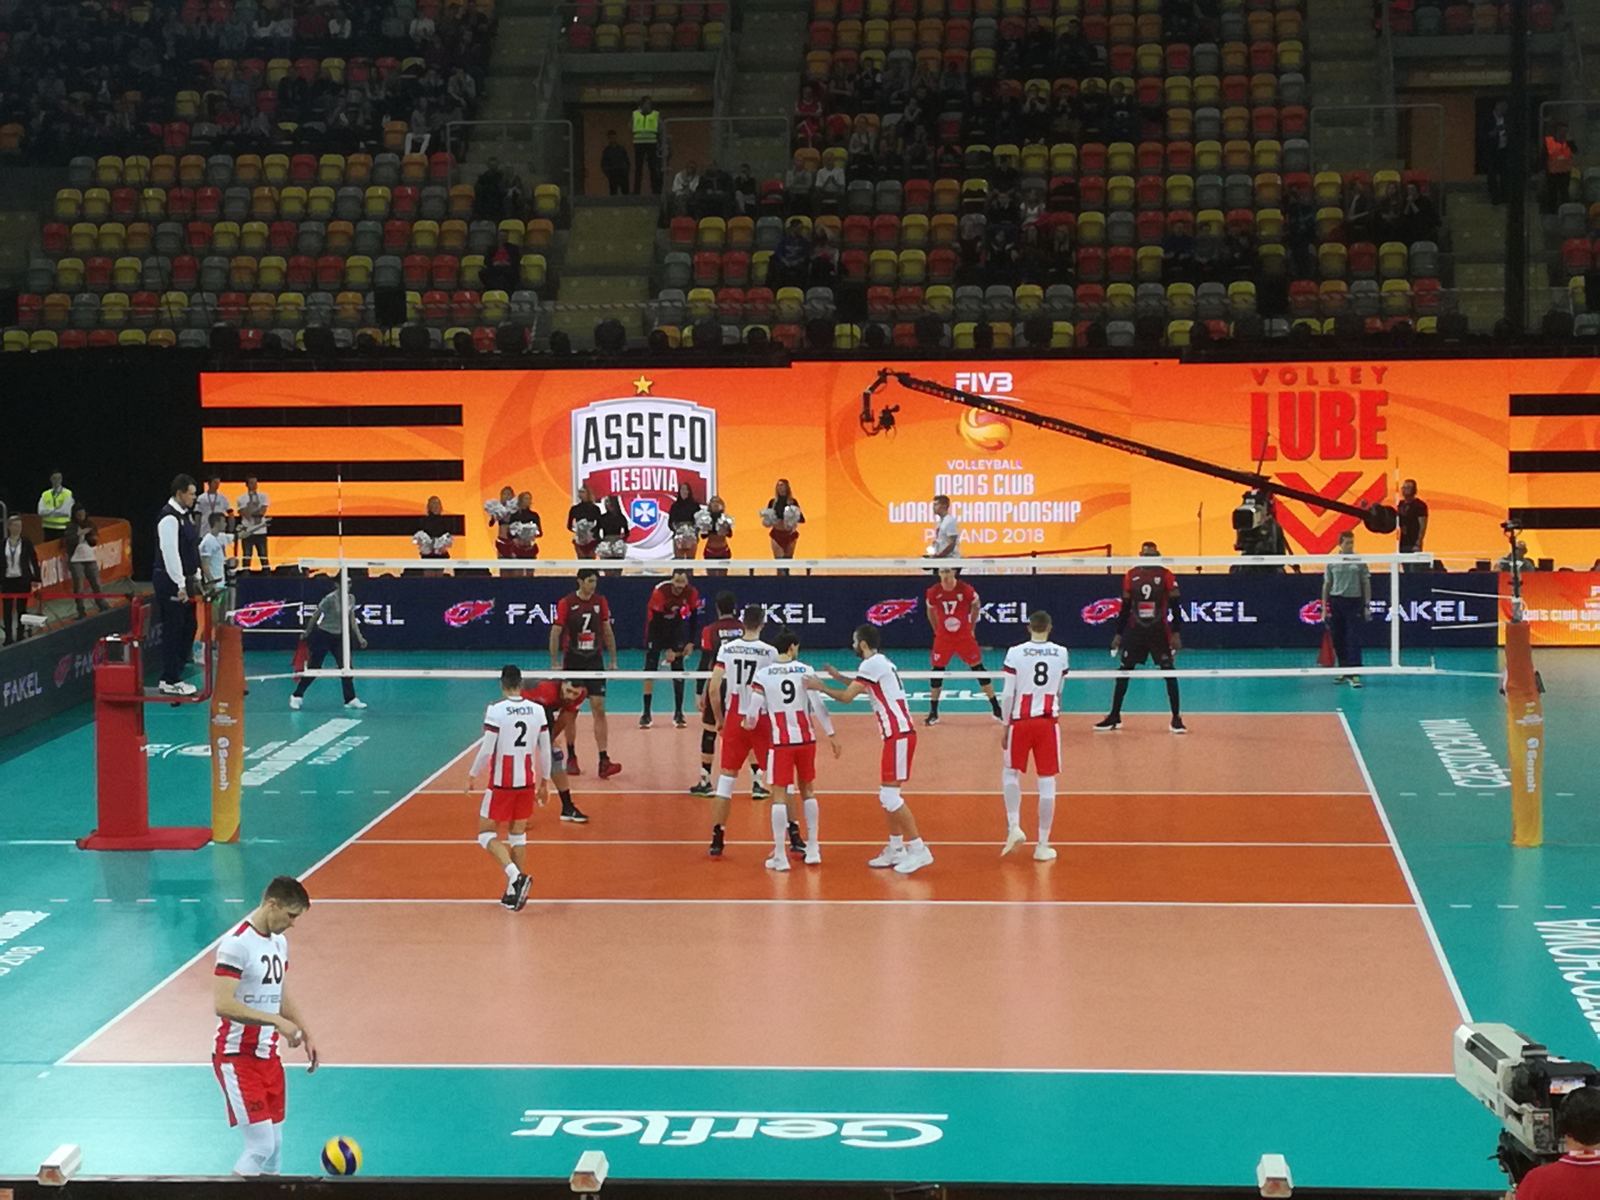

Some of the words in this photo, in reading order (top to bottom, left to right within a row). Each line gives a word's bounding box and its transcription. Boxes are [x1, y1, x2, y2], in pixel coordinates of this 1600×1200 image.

[955, 372, 1013, 393] FIVB
[1252, 366, 1387, 386] VOLLEY
[1251, 390, 1388, 461] LUBE
[582, 412, 707, 464] ASSECO
[946, 459, 1023, 470] VOLLEYBALL
[610, 468, 679, 493] RESOVIA
[993, 473, 1034, 496] CLUB
[951, 501, 1081, 523] CHAMPIONSHIP
[924, 528, 999, 543] PAND
[1002, 528, 1045, 543] 2018
[1141, 584, 1151, 600] 9
[942, 601, 957, 615] 17
[1368, 600, 1478, 621] FAKEL
[1023, 648, 1059, 657] SCHULZ
[733, 659, 757, 685] 17
[1034, 661, 1048, 687] 8
[3, 671, 43, 707] FAKEL
[781, 680, 796, 703] 9
[514, 720, 527, 747] 2
[261, 954, 283, 985] 20
[511, 1110, 948, 1149] Gerflor
